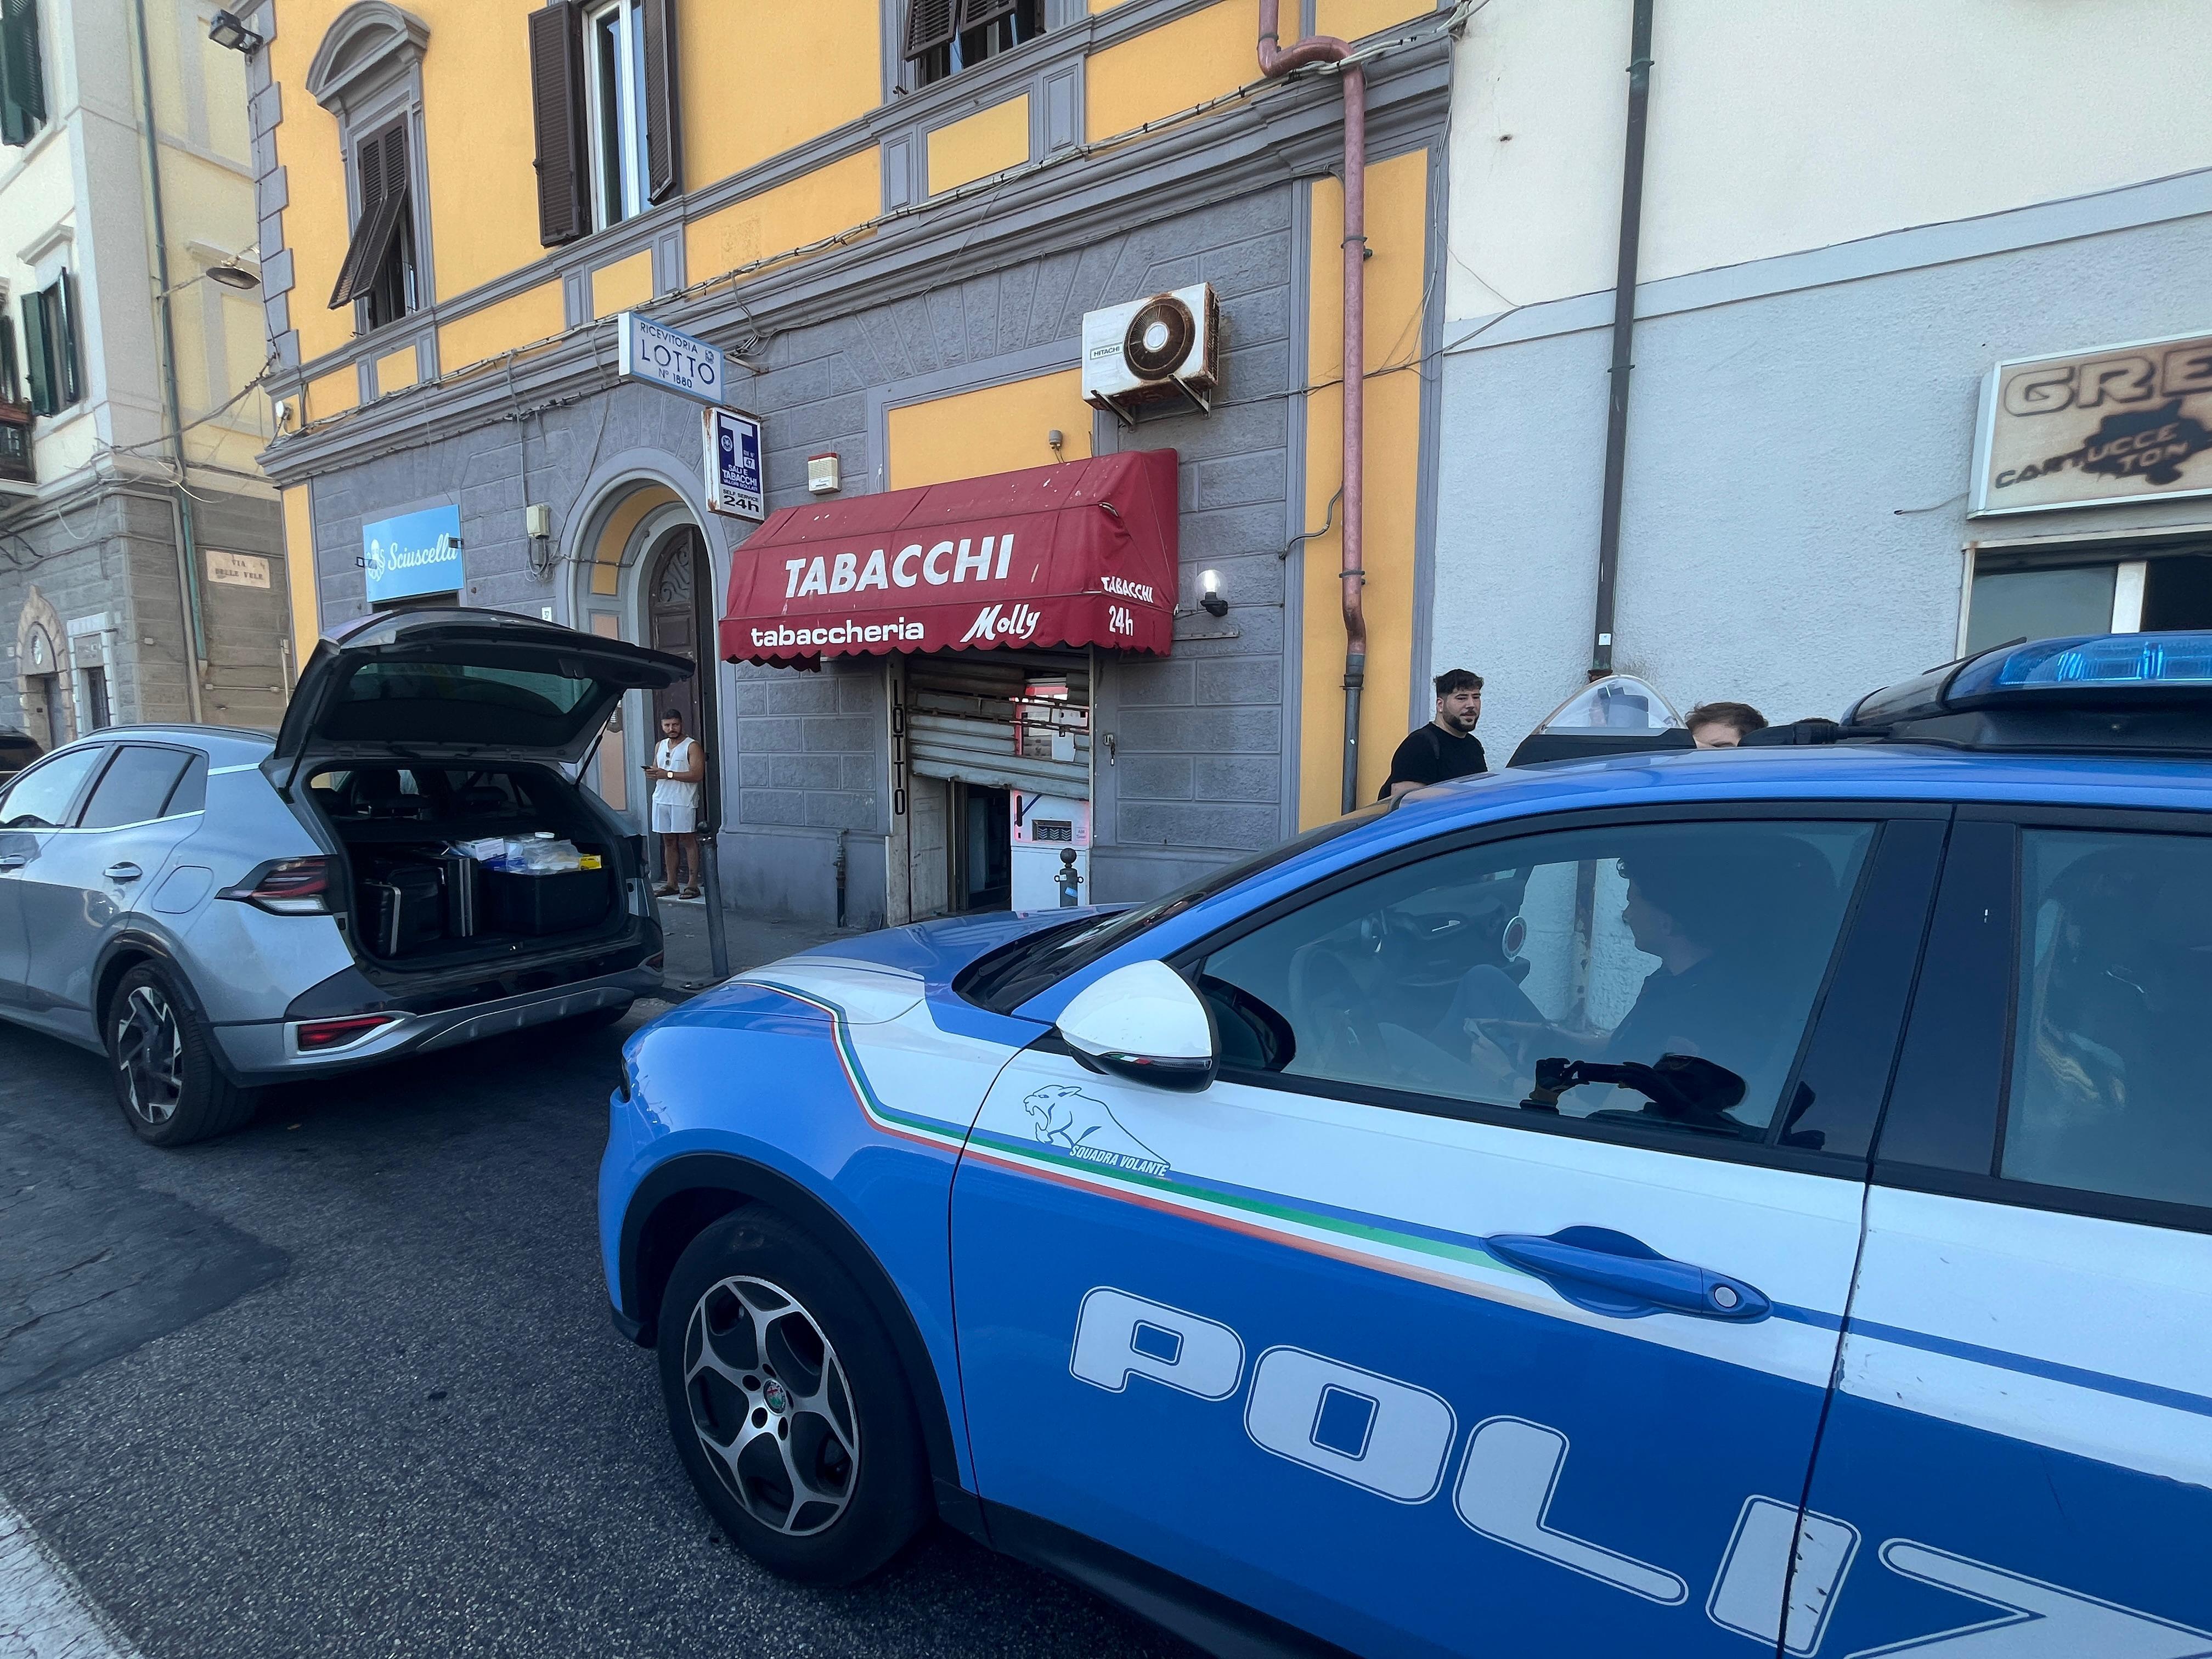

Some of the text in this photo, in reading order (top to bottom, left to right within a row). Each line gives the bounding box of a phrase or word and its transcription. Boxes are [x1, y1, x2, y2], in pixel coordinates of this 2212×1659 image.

[640, 322, 698, 354] RICEVITORIA
[1094, 346, 1120, 357] HITACHI
[641, 339, 715, 385] LOTTO
[673, 373, 692, 388] 1880
[2005, 346, 2212, 416] GRE
[720, 415, 753, 468] T
[721, 469, 757, 486] TABACCHI
[728, 464, 742, 474] SALI
[724, 495, 759, 513] 24h
[737, 493, 759, 503] SERVICE
[785, 533, 1014, 599] TABACCHI
[1101, 575, 1154, 603] TABACCHI
[751, 603, 1041, 647] tabaccheria Molly
[1109, 605, 1134, 637] 24h
[893, 679, 906, 816] LOTTO
[1070, 1145, 1169, 1176] SQUADRA VOLANTE
